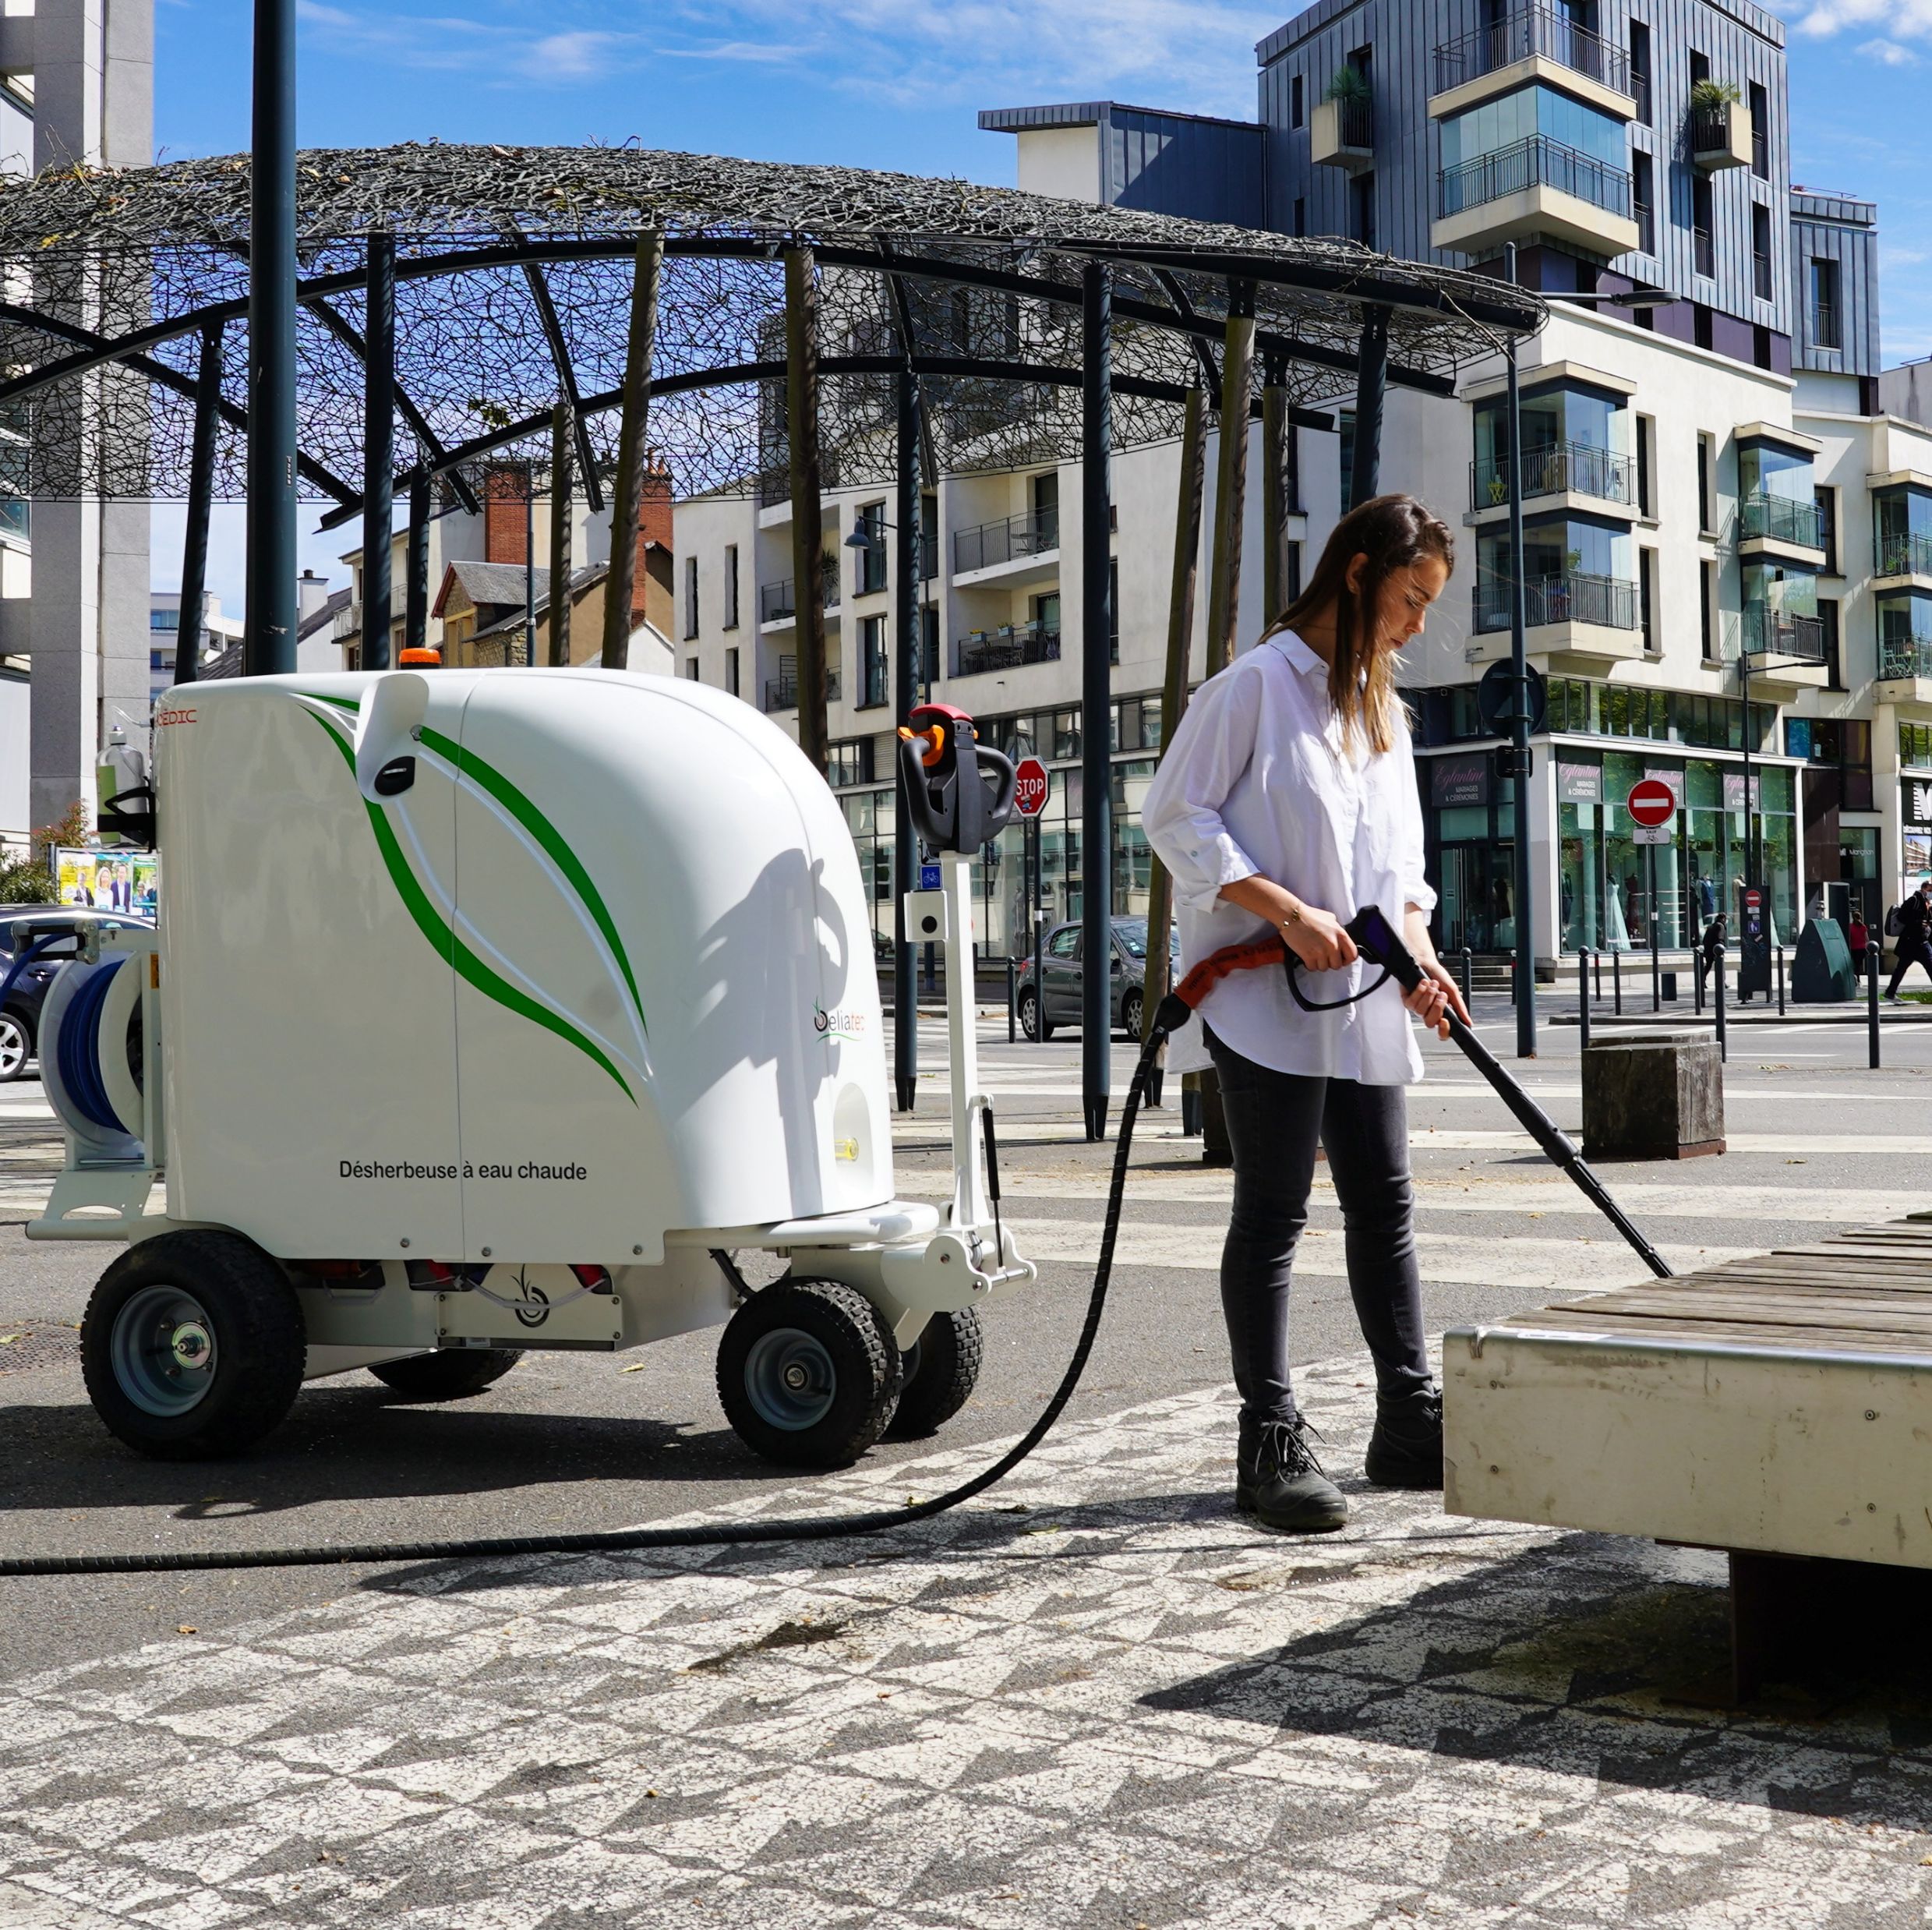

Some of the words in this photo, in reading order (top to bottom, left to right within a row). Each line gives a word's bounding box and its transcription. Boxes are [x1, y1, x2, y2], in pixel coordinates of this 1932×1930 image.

[1016, 778, 1044, 796] STOP
[339, 1161, 457, 1179] Désherbeuse
[462, 1160, 473, 1179] à
[479, 1165, 512, 1179] eau
[517, 1161, 587, 1180] chaude
